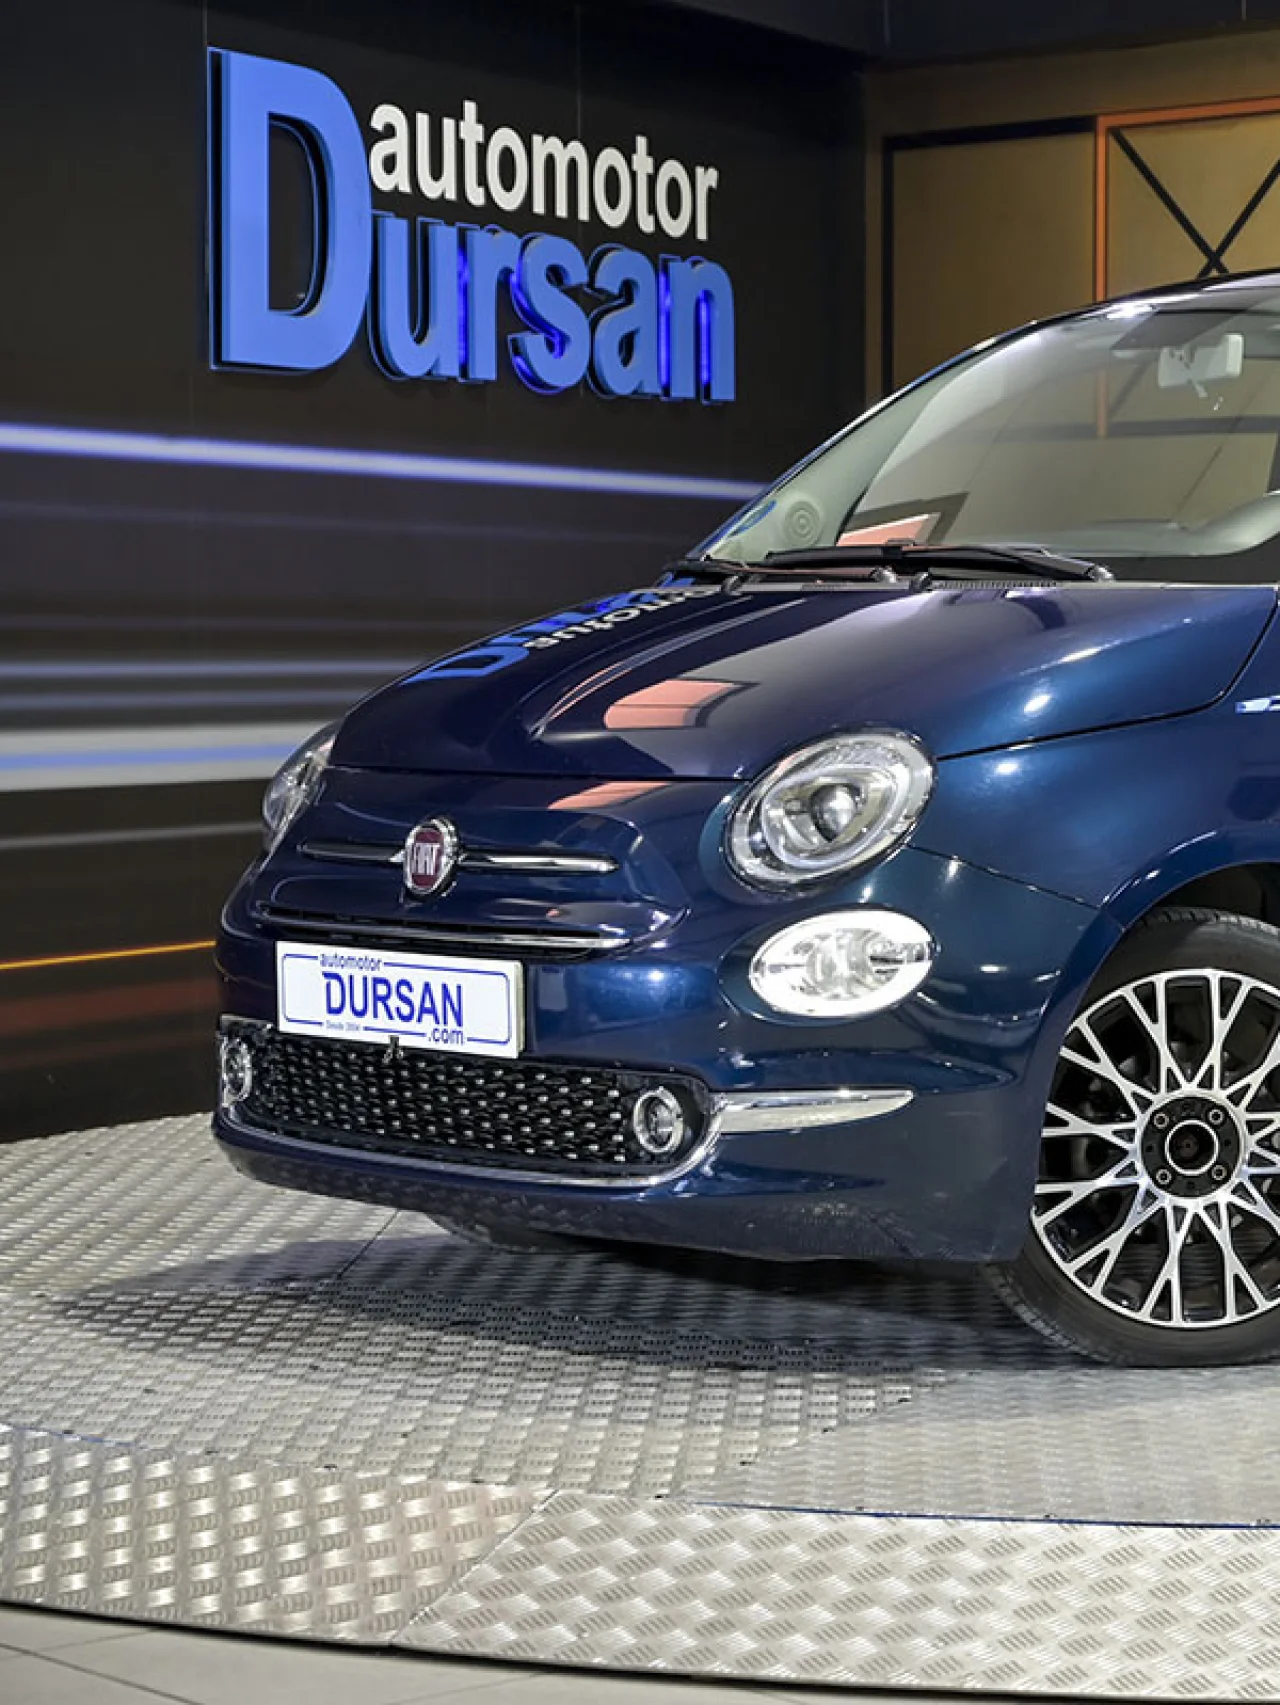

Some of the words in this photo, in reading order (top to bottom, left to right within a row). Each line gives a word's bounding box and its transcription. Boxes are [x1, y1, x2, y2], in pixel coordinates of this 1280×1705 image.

[369, 100, 717, 240] automotor
[207, 46, 736, 404] Dursan
[320, 952, 382, 971] automotor
[321, 971, 464, 1027] DURSAN
[428, 1027, 465, 1046] .com
